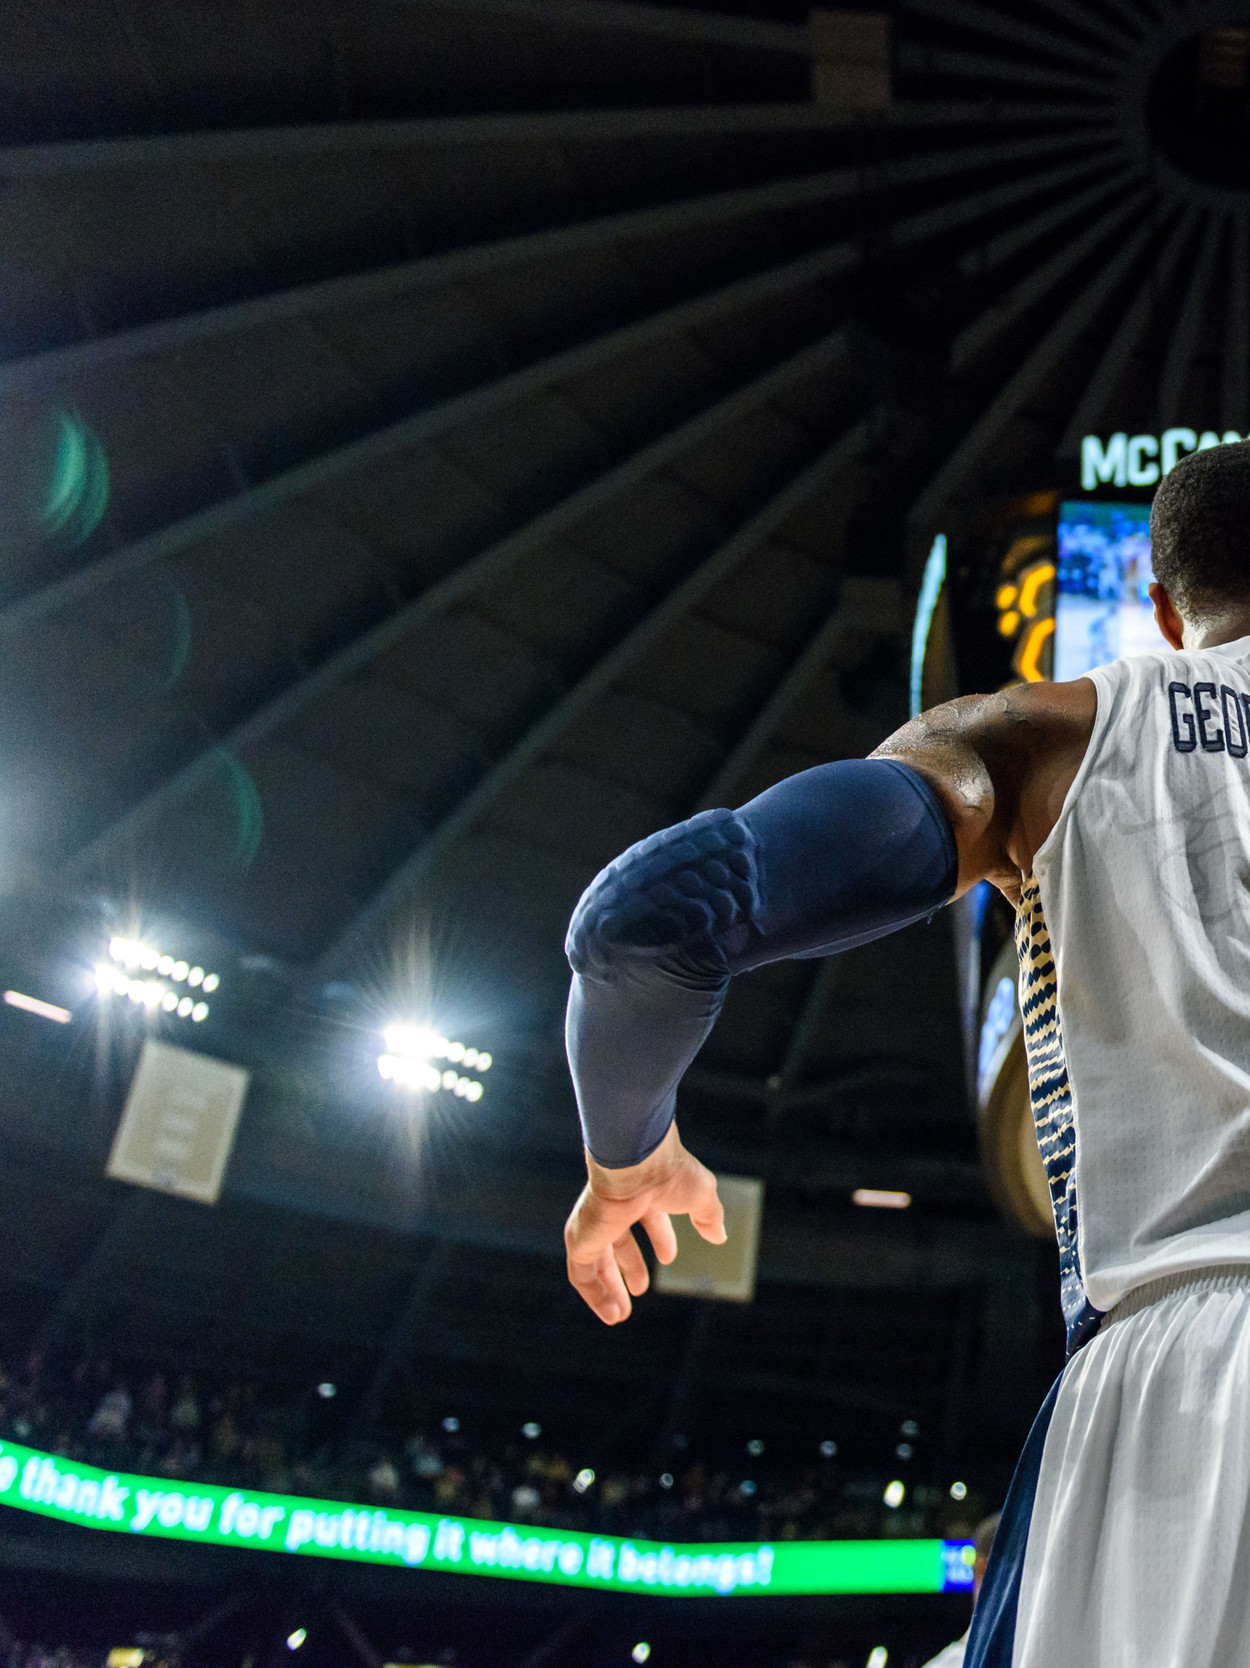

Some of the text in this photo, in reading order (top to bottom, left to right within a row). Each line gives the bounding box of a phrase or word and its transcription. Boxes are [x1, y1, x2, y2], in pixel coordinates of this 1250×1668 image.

[18, 1455, 130, 1522] thank
[129, 1488, 215, 1534] you
[218, 1492, 286, 1541] for
[284, 1508, 432, 1568] putting
[432, 1518, 465, 1563] it
[468, 1526, 585, 1577] where
